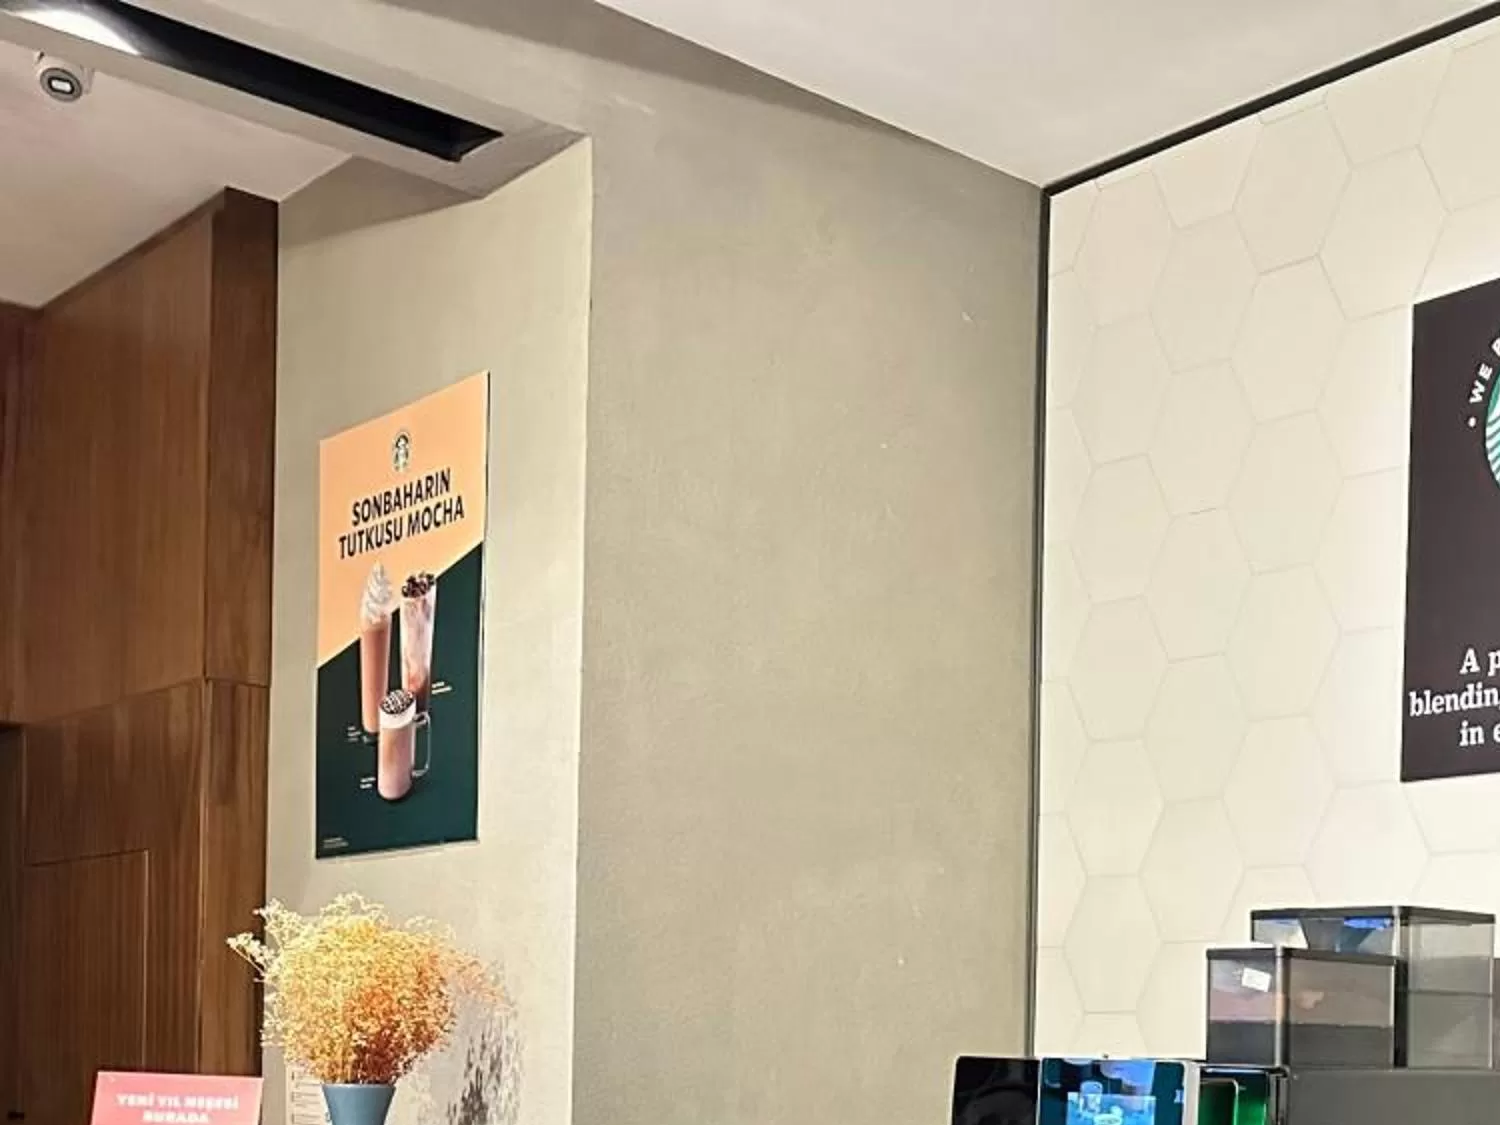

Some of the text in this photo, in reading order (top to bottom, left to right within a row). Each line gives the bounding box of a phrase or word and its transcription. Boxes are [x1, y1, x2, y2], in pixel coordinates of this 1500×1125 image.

[1469, 362, 1492, 404] WE
[352, 467, 451, 527] SONBAHARIN
[338, 495, 465, 560] TUTKUSU MOCHA
[1460, 647, 1480, 675] A
[1459, 720, 1485, 747] in
